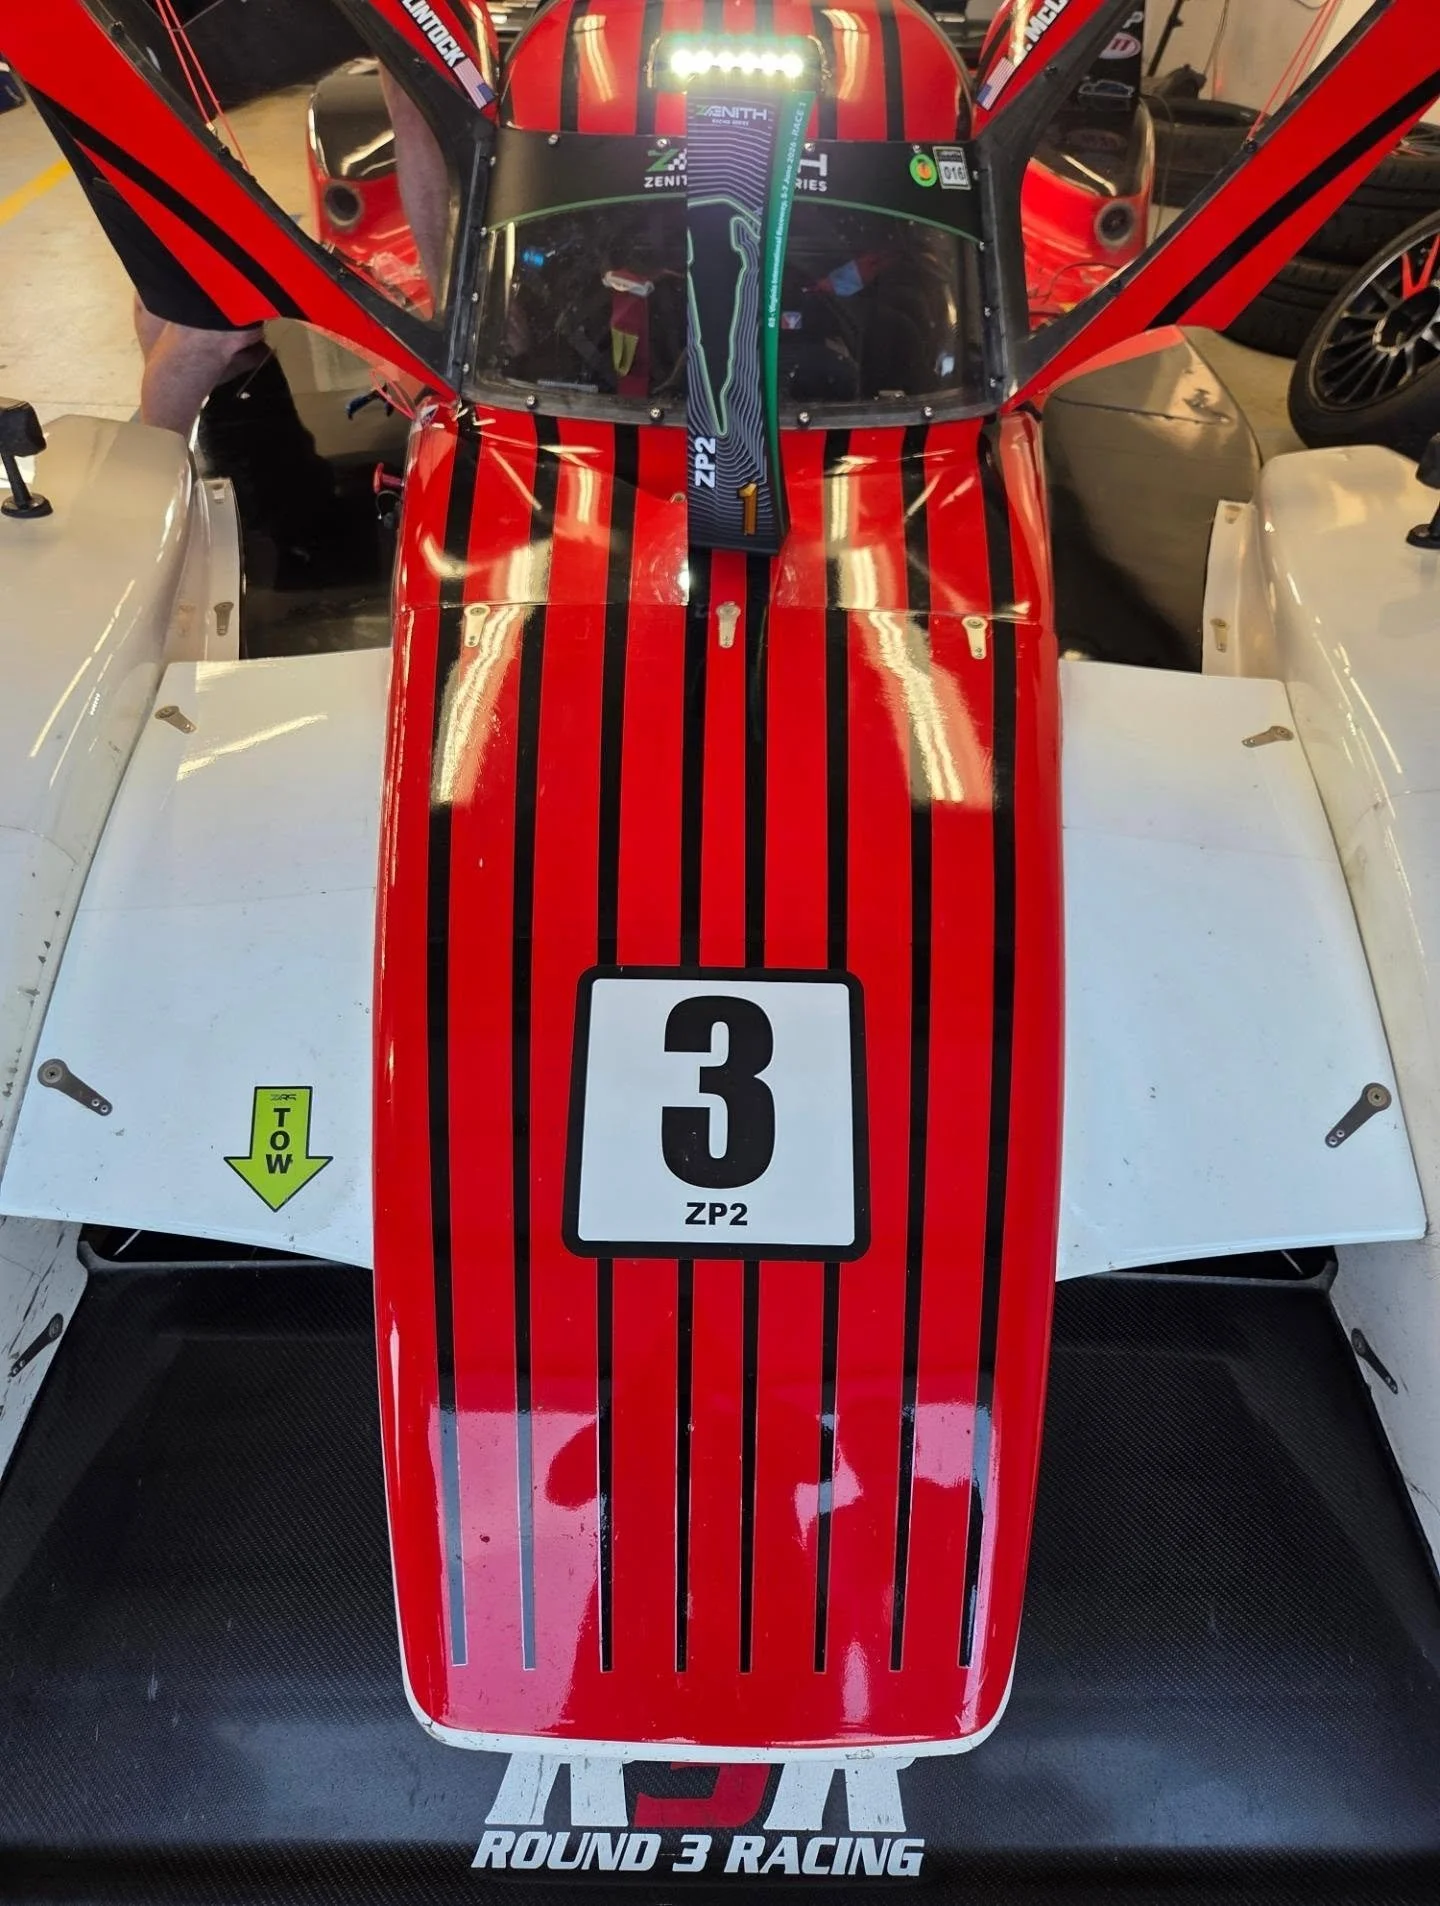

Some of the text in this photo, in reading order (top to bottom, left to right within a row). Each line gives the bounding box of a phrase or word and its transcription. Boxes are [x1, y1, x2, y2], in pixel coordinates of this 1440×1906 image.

[696, 104, 768, 121] ZENITH
[644, 175, 828, 192] ZENIT RIES
[771, 237, 782, 284] International
[784, 165, 793, 184] June
[792, 109, 804, 136] RACE
[694, 436, 716, 488] ZP2
[738, 482, 758, 536] 1
[661, 995, 776, 1189] 3
[265, 1107, 294, 1174] TOW
[684, 1201, 749, 1226] ZP2
[471, 1830, 925, 1877] ROUND 3 RACING
